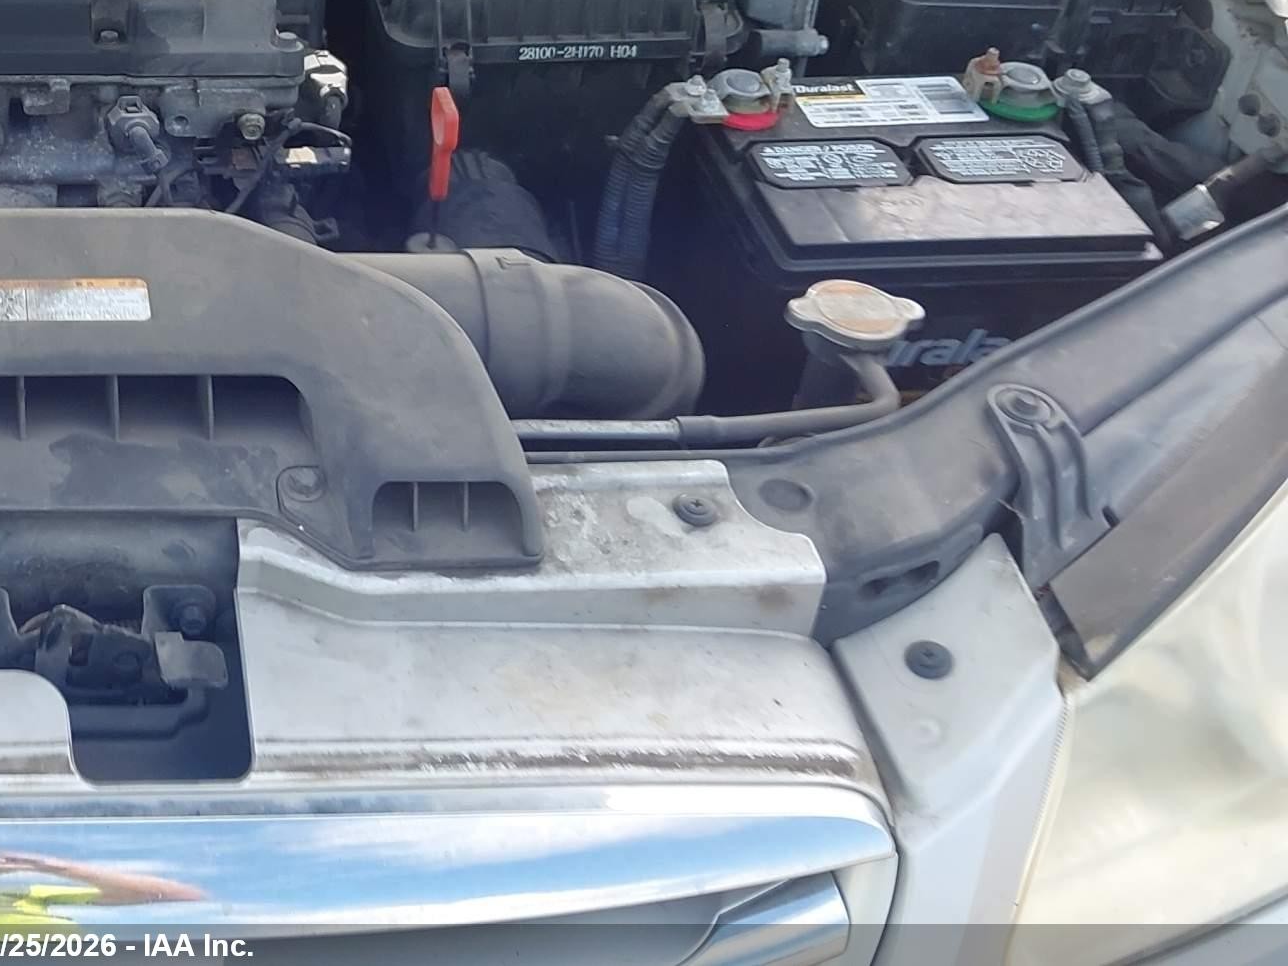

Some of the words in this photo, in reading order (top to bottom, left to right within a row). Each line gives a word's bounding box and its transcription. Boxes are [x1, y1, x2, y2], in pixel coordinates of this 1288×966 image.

[518, 45, 605, 61] 28100-2H170
[610, 44, 638, 59] H04
[792, 83, 854, 94] Duralast
